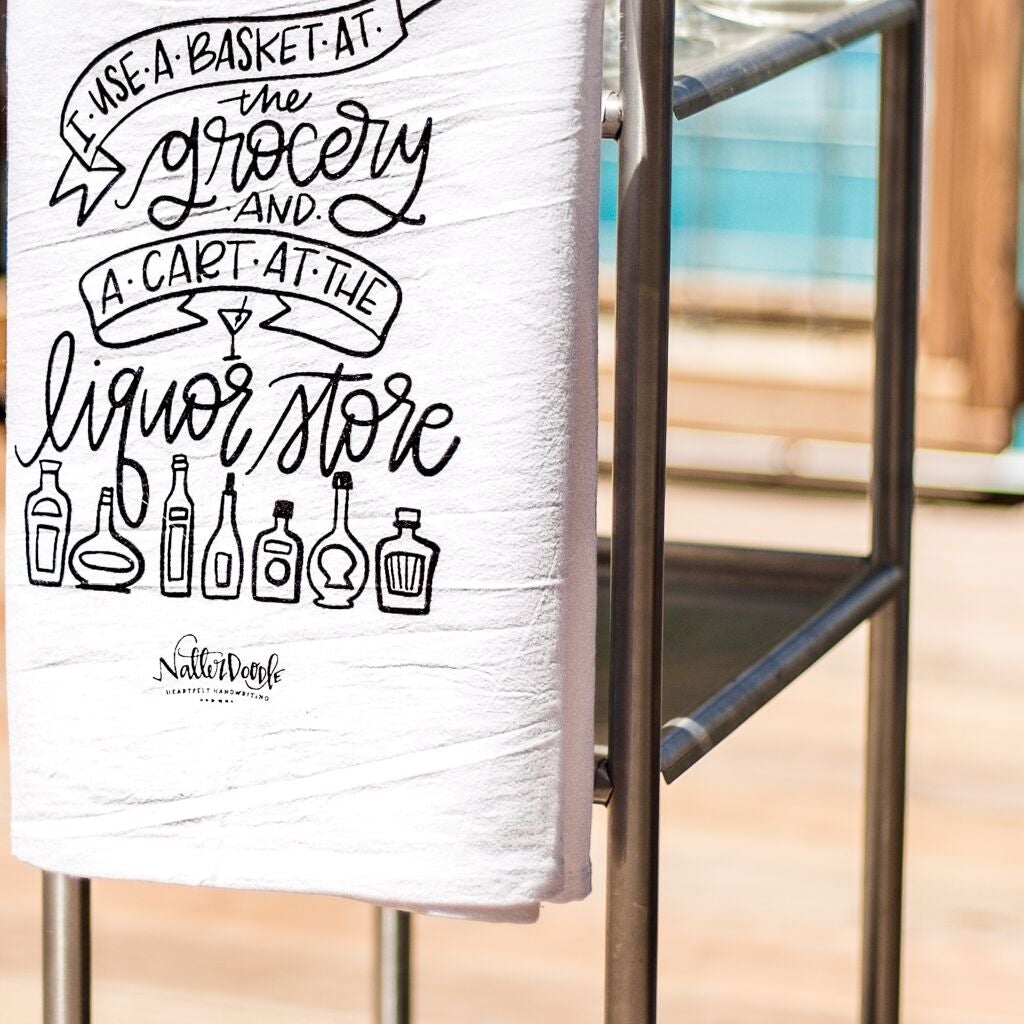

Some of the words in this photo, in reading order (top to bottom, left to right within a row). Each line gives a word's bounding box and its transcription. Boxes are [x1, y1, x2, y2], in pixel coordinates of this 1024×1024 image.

[88, 51, 145, 116] USE
[154, 39, 174, 84] A
[186, 23, 323, 76] BASKET
[334, 8, 374, 60] AT
[217, 83, 313, 117] the
[115, 100, 433, 238] grocery
[234, 192, 317, 224] AND
[101, 269, 124, 314] A
[142, 240, 258, 293] CART
[263, 241, 320, 287] AT
[323, 255, 388, 316] THE
[15, 330, 254, 528] liquor
[245, 363, 462, 478] store
[165, 687, 211, 695] HEARTFELT
[213, 688, 270, 702] HANDWRITING
